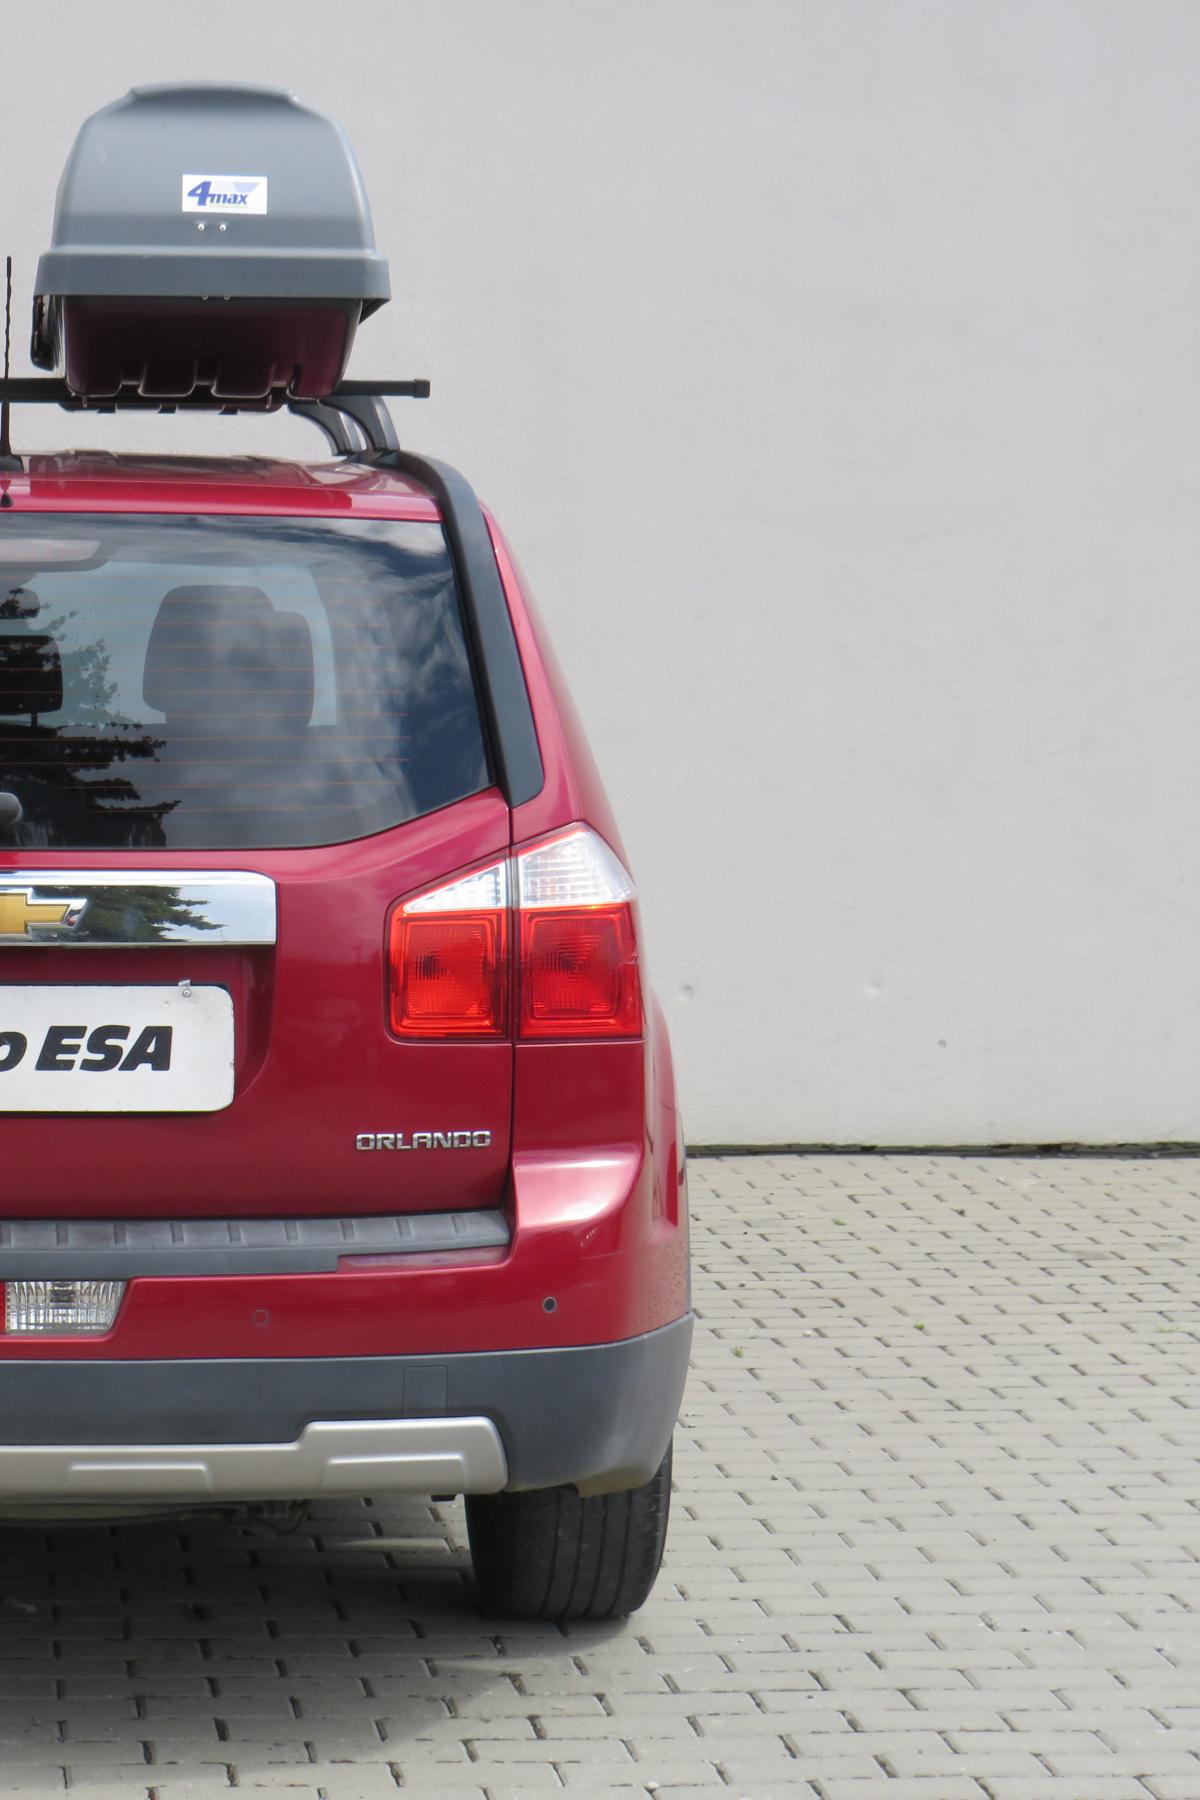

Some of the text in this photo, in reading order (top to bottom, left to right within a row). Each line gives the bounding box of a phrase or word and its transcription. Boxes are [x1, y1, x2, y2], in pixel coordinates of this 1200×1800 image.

[187, 181, 248, 206] 4max
[35, 1025, 173, 1072] ESA
[356, 1130, 491, 1150] ORLANDO
